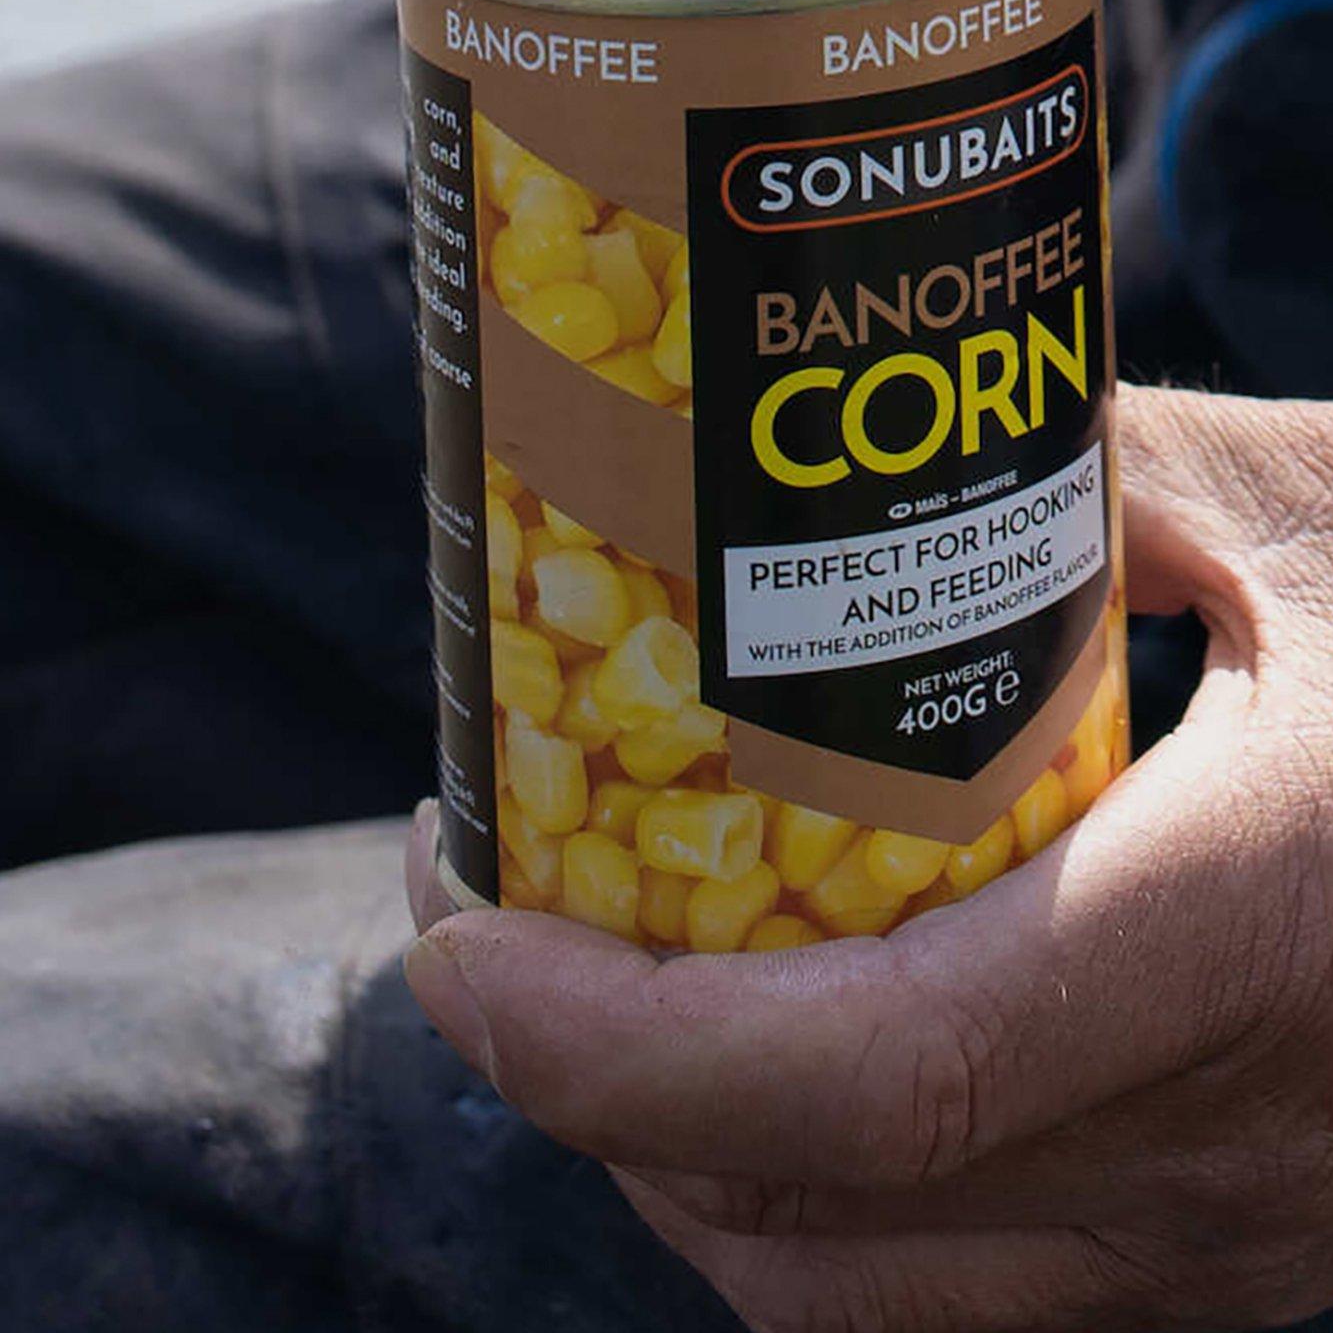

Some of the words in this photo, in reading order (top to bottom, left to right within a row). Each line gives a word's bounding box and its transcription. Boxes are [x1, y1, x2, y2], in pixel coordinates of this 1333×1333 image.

[444, 7, 659, 83] BANOFFEE
[423, 98, 462, 136] corn,
[429, 140, 461, 171] and
[758, 85, 1077, 213] SONUBAITS
[756, 206, 1086, 356] BANOFFEE
[750, 284, 1088, 489] CORN
[749, 543, 906, 592] PERFECT
[915, 525, 980, 569] FOR
[987, 464, 1095, 547] HOOKING
[748, 641, 801, 662] WITH
[807, 636, 847, 658] THE
[849, 617, 944, 653] ADDITION
[946, 608, 972, 630] OF
[973, 575, 1052, 623] BANOFFEE
[841, 586, 920, 627] AND
[930, 537, 1053, 609] FEEDING
[895, 682, 987, 736] 400G
[903, 673, 943, 699] NET
